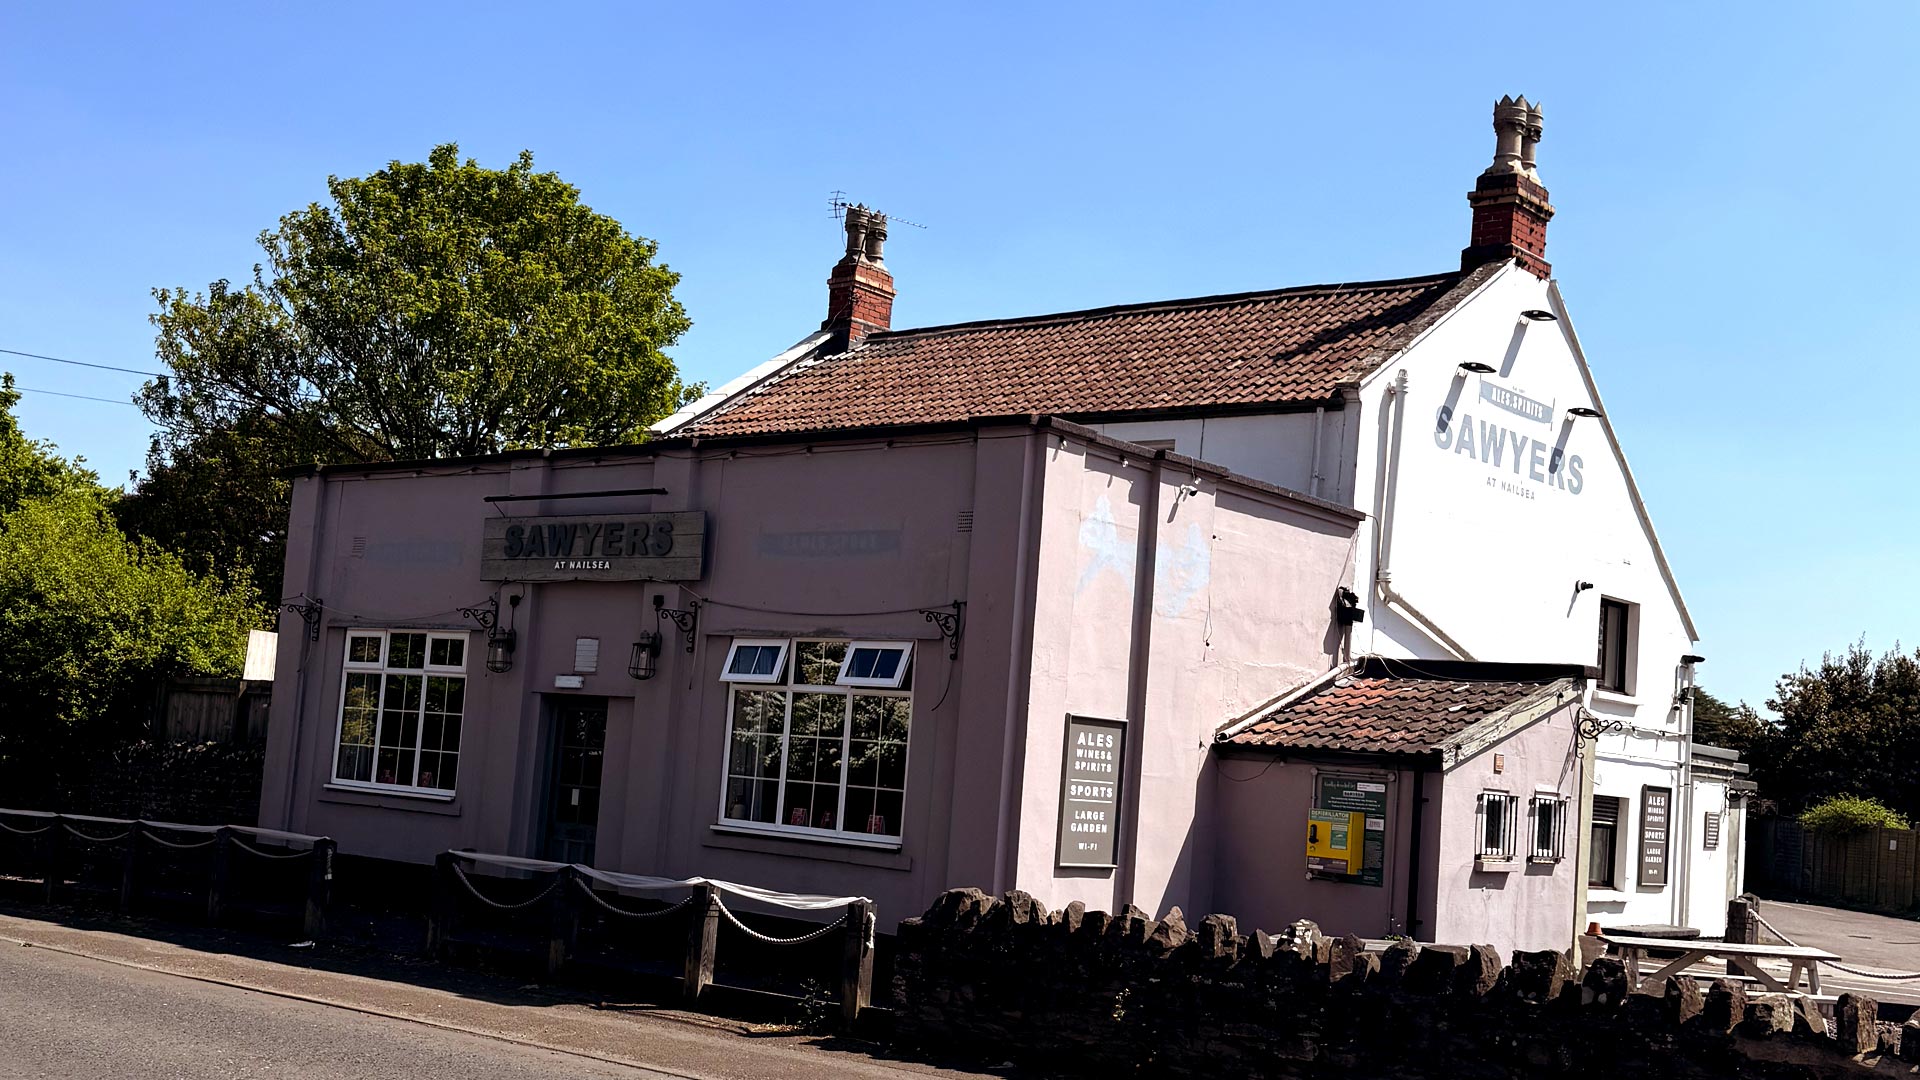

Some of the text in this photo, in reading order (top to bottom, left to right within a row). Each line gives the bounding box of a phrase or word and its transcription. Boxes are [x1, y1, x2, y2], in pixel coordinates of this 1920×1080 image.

[1434, 404, 1584, 495] SAWYERS
[1486, 476, 1535, 501] AT NAILSEA
[503, 520, 674, 558] SAWYERS
[554, 560, 611, 570] AT NAILSEA
[1077, 732, 1113, 748] ALES
[1075, 761, 1112, 773] SPIRITS
[1070, 785, 1113, 798] SPORTS
[1648, 796, 1664, 806] ALES
[1074, 810, 1105, 821] LARGE
[1647, 815, 1664, 823] SPIRITS
[1071, 823, 1108, 833] GARDEN
[1645, 831, 1664, 840] SPORTS
[1078, 842, 1098, 851] WI-FI
